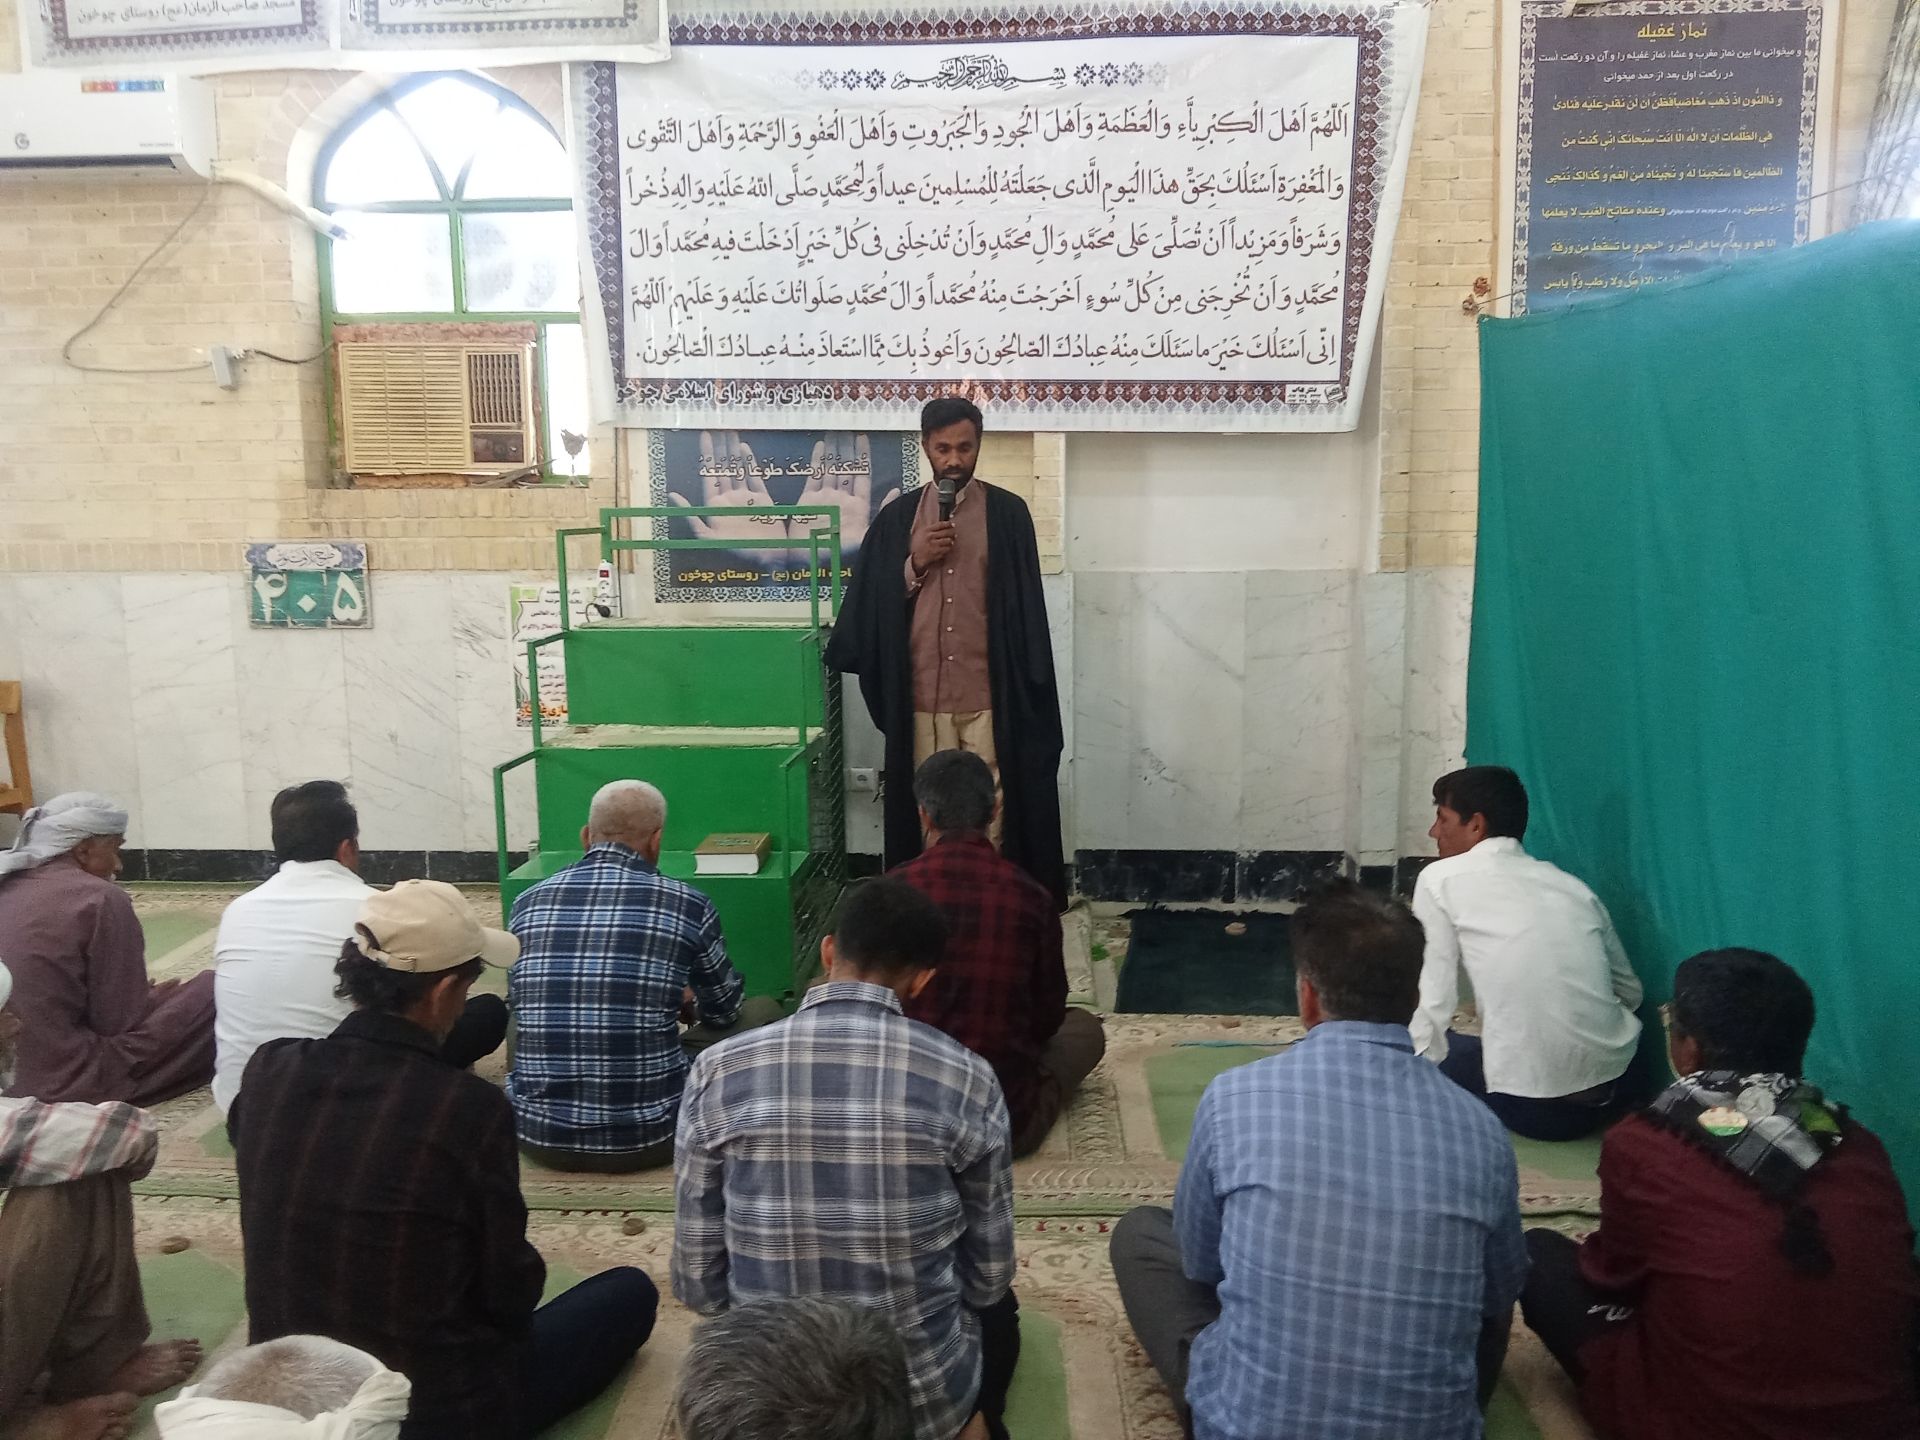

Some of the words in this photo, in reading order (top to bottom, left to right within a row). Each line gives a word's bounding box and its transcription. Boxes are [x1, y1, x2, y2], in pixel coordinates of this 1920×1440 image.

[1637, 22, 1676, 42] غفیله
[1680, 22, 1708, 41] نماز
[1617, 52, 1625, 61] را
[1651, 52, 1666, 60] نماز
[1695, 50, 1718, 60] مغرب
[1720, 50, 1735, 60] نماز
[1737, 51, 1752, 59] بین
[1753, 48, 1761, 56] ما
[1762, 47, 1795, 58] میخوانی
[1560, 53, 1582, 62] رکعت
[1603, 72, 1635, 82] میخوانی
[1656, 71, 1663, 81] از
[1666, 72, 1680, 80] بعد
[1682, 70, 1697, 80] اول
[1699, 69, 1722, 80] رکعت
[1723, 70, 1733, 80] در
[663, 382, 713, 405] اسلامی
[715, 382, 763, 405] شورای
[778, 382, 834, 405] دهیاری
[678, 568, 716, 583] چوخون
[717, 568, 759, 581] روستای
[791, 567, 826, 581] المان
